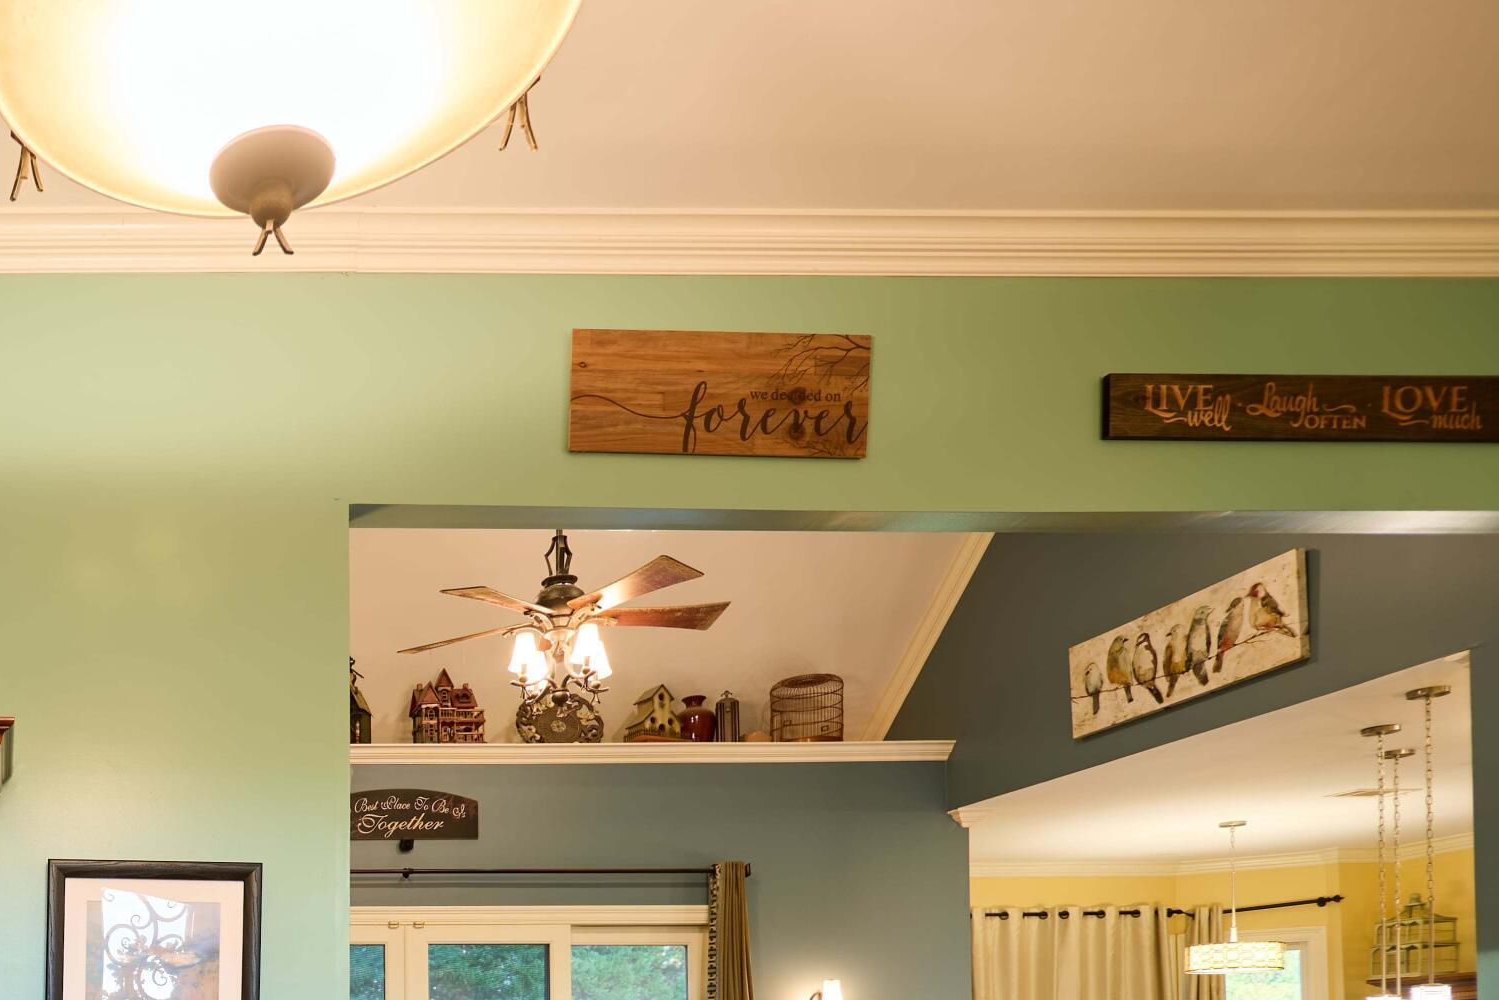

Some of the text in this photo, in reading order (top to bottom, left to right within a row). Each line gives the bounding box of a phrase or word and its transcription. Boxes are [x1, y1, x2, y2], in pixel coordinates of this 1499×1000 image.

[680, 380, 869, 453] forever
[749, 390, 769, 400] we
[824, 392, 841, 402] on
[1143, 384, 1233, 432] LIVE well
[1245, 381, 1367, 429] Laugh OFTEN
[1380, 385, 1484, 430] LOVE much
[354, 795, 466, 819] Best Place To Be Is
[357, 812, 444, 838] Together
